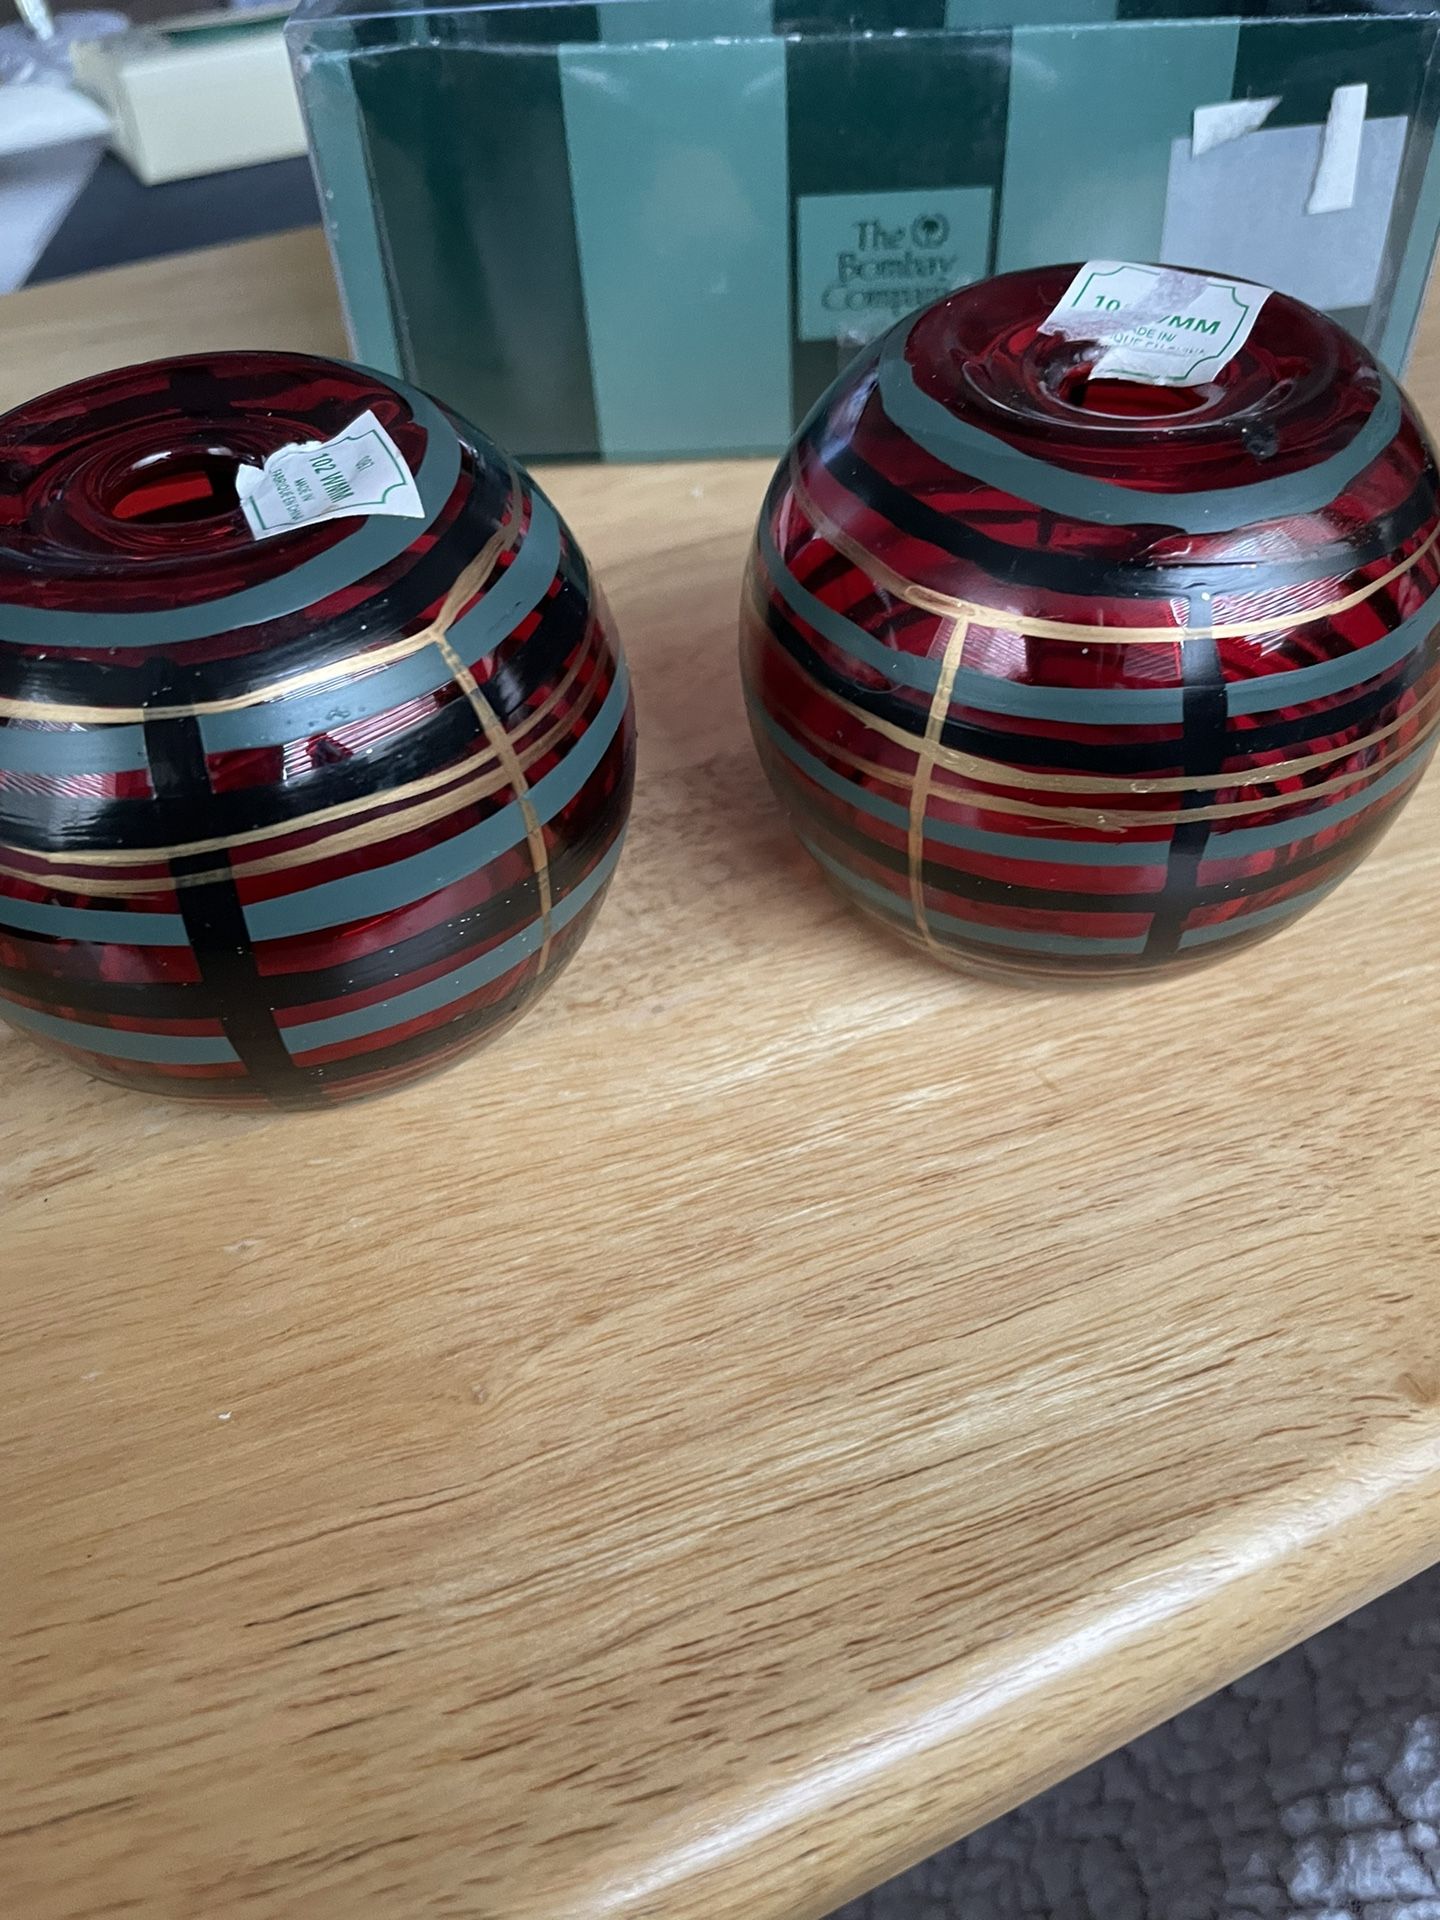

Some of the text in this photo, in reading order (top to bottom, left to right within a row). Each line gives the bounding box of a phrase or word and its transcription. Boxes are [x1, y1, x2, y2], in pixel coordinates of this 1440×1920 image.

[852, 219, 905, 251] The
[837, 251, 957, 283] Bombay
[309, 453, 337, 474] 102
